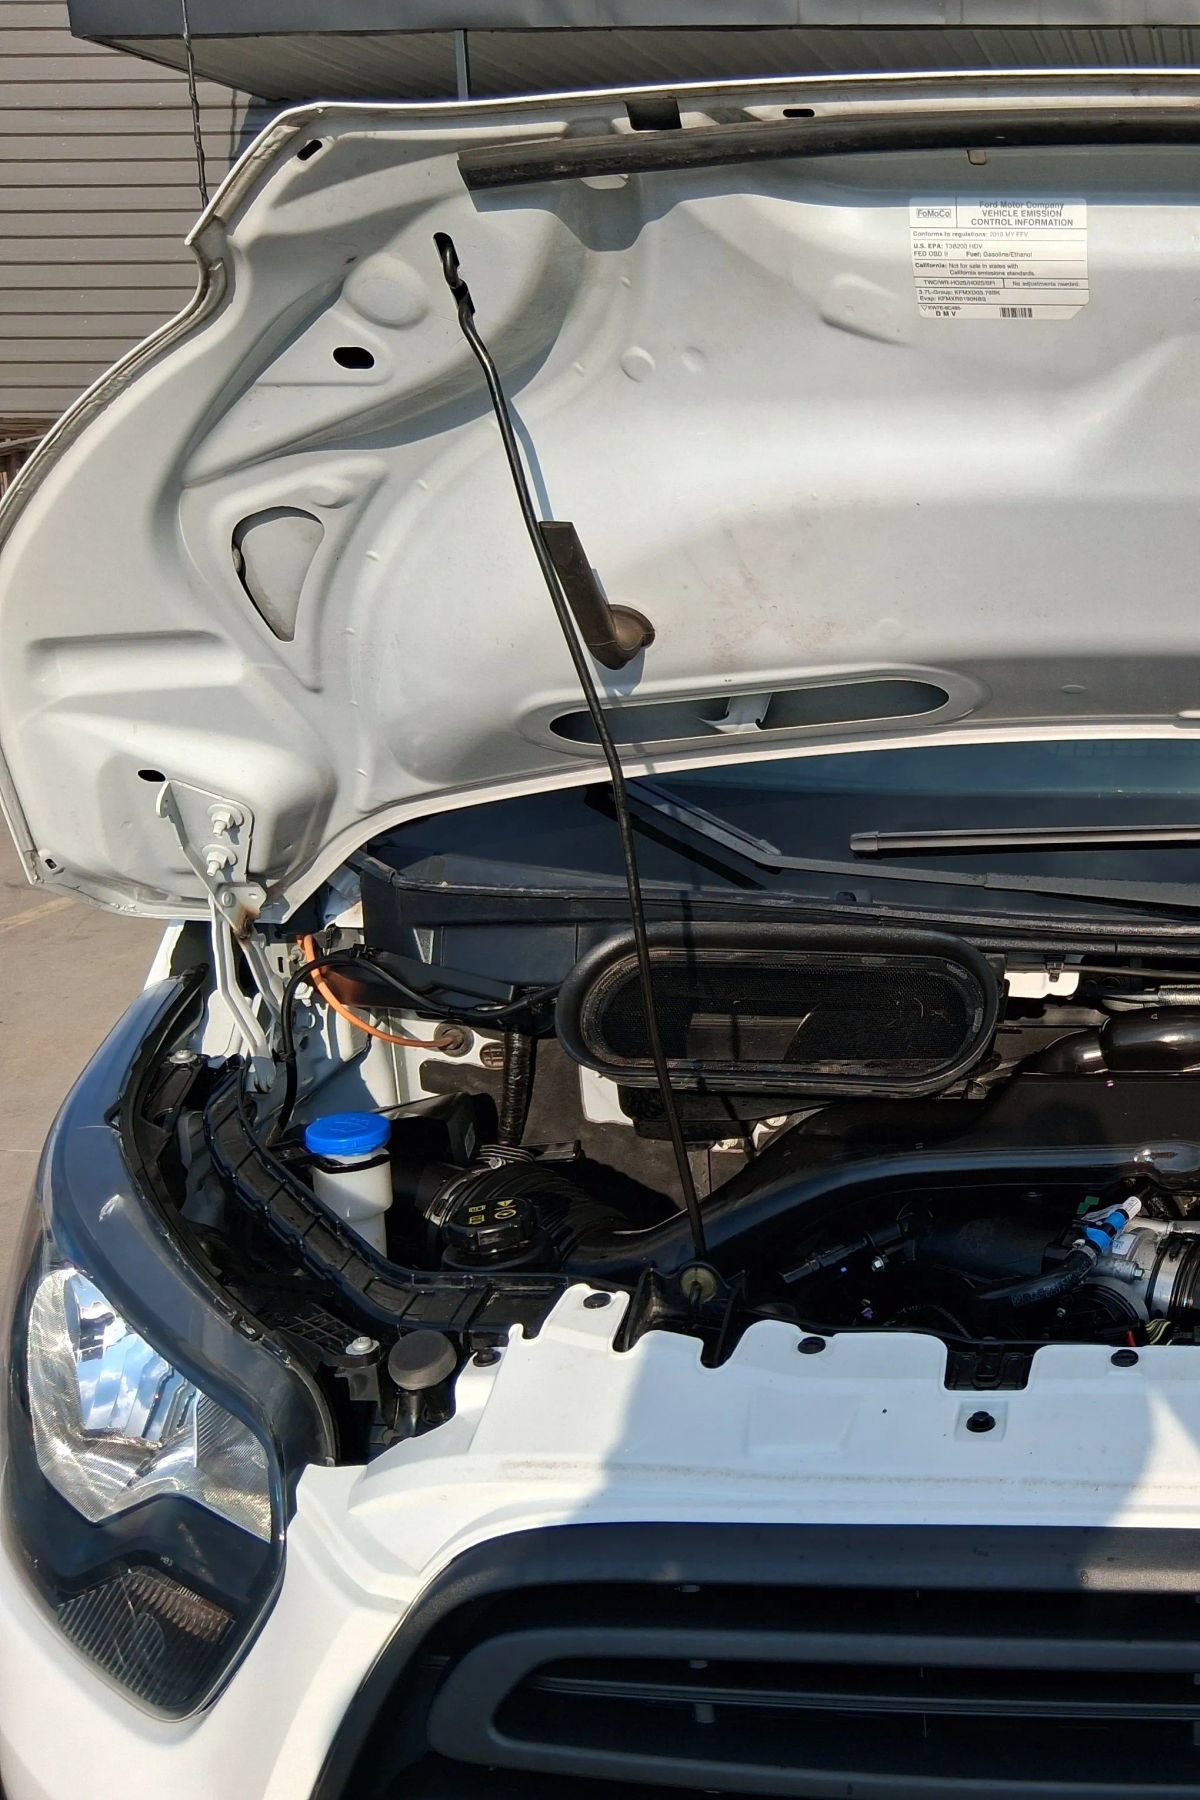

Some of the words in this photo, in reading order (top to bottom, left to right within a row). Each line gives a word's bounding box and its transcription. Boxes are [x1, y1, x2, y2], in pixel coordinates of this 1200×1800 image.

[1026, 201, 1065, 210] Company
[917, 209, 951, 218] FoMoCo
[982, 209, 1018, 217] VEHICLE
[1021, 209, 1062, 217] EMISSION
[971, 218, 1013, 226] CONTROL
[1015, 218, 1073, 226] INFORMATION
